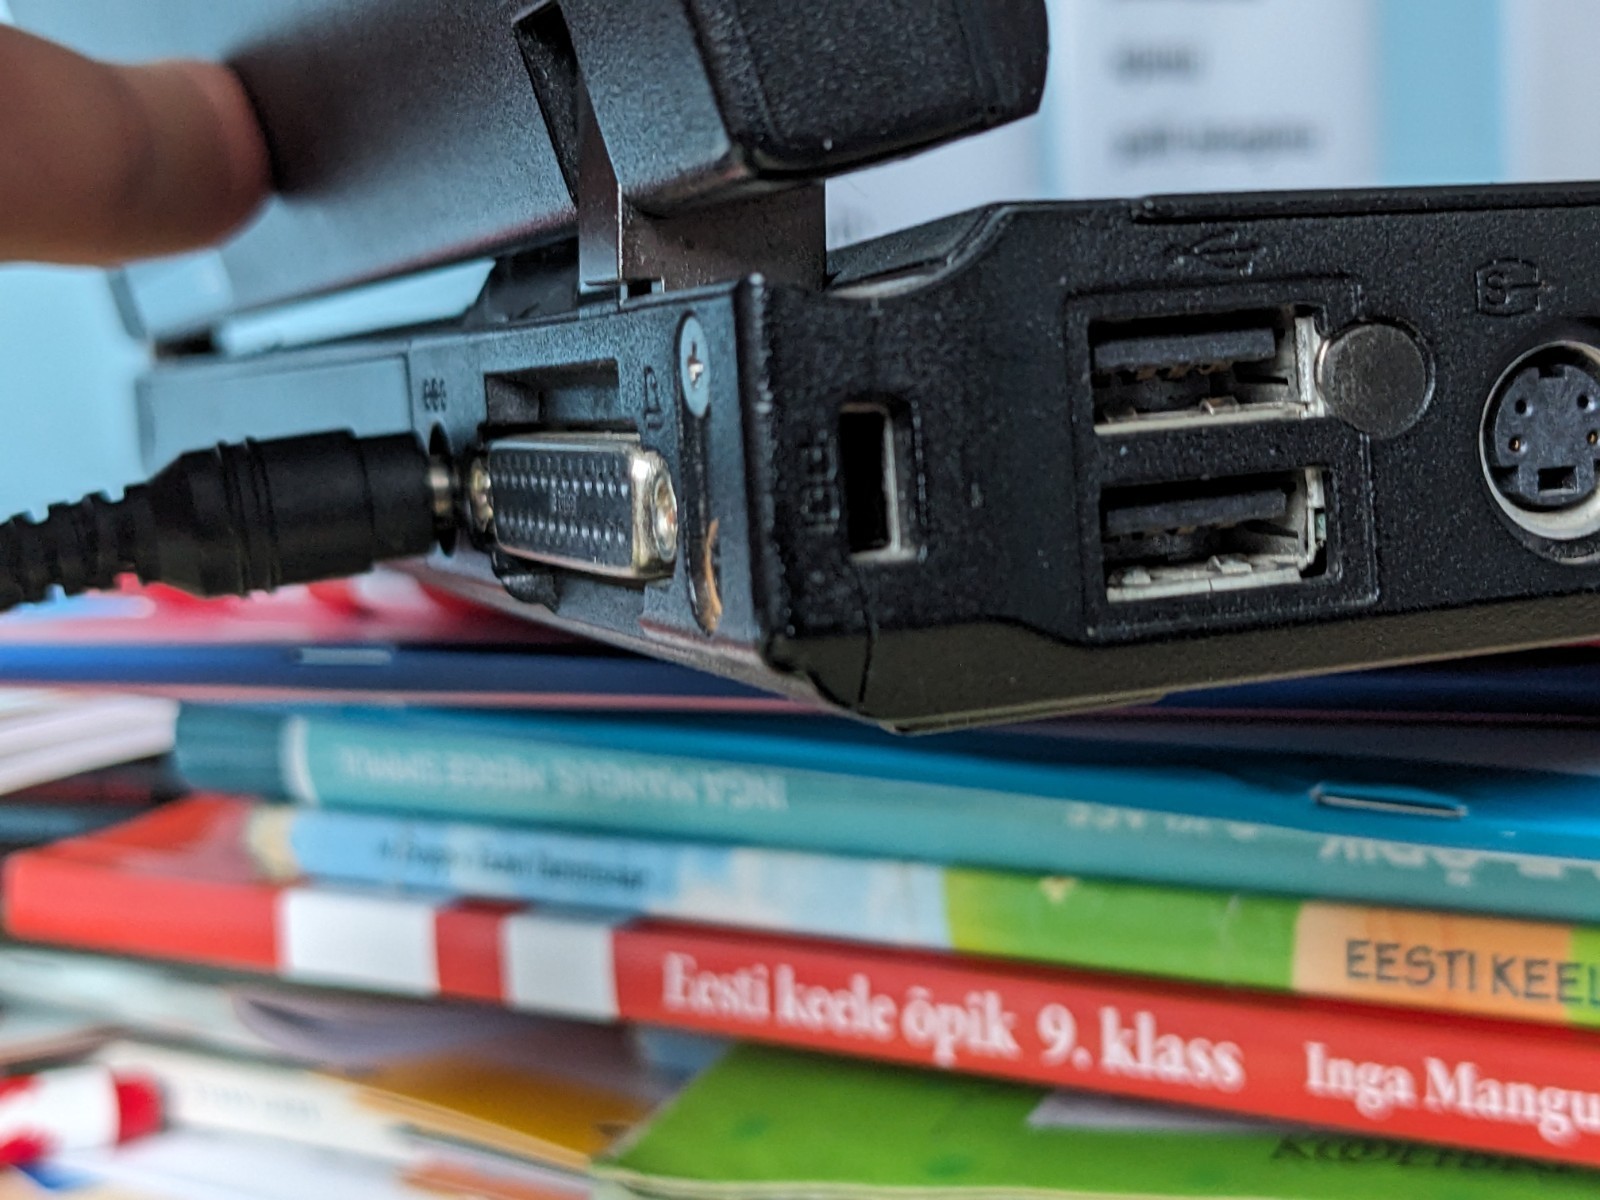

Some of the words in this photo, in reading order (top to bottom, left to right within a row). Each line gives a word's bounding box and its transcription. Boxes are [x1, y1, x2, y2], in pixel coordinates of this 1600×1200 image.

[1345, 938, 1477, 993] EESTI
[663, 951, 771, 1024] Eesti
[774, 962, 899, 1043] keele
[902, 984, 1021, 1068] õpik
[1036, 1003, 1093, 1071] 9.
[1099, 1006, 1246, 1094] klass
[1304, 1041, 1418, 1120] Inga
[1423, 1056, 1600, 1146] Mangu
